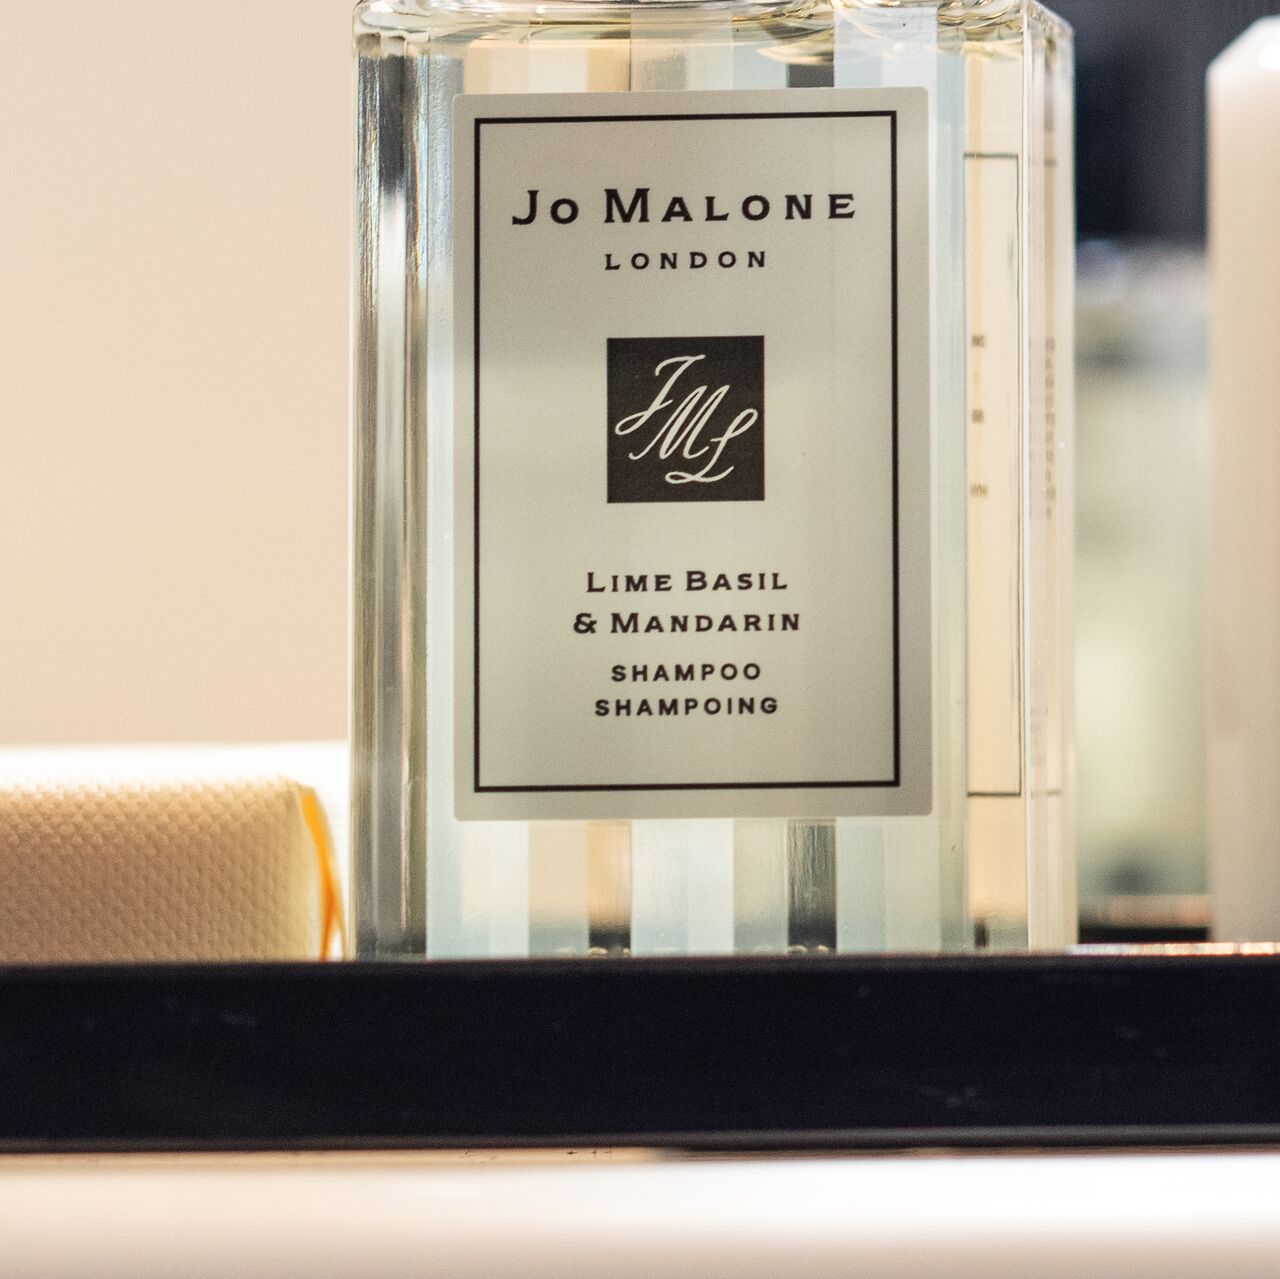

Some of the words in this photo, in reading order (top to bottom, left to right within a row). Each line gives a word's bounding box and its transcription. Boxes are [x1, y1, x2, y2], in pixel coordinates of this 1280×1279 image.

[511, 189, 580, 226] JO
[603, 187, 855, 224] MALONE
[604, 250, 766, 272] LONDON
[586, 571, 672, 594] LIME
[685, 569, 788, 592] BASIL
[572, 612, 598, 635] &
[610, 612, 800, 634] MANDARIN
[611, 662, 762, 683] SHAMPOO
[594, 696, 778, 718] SHAMPOING
